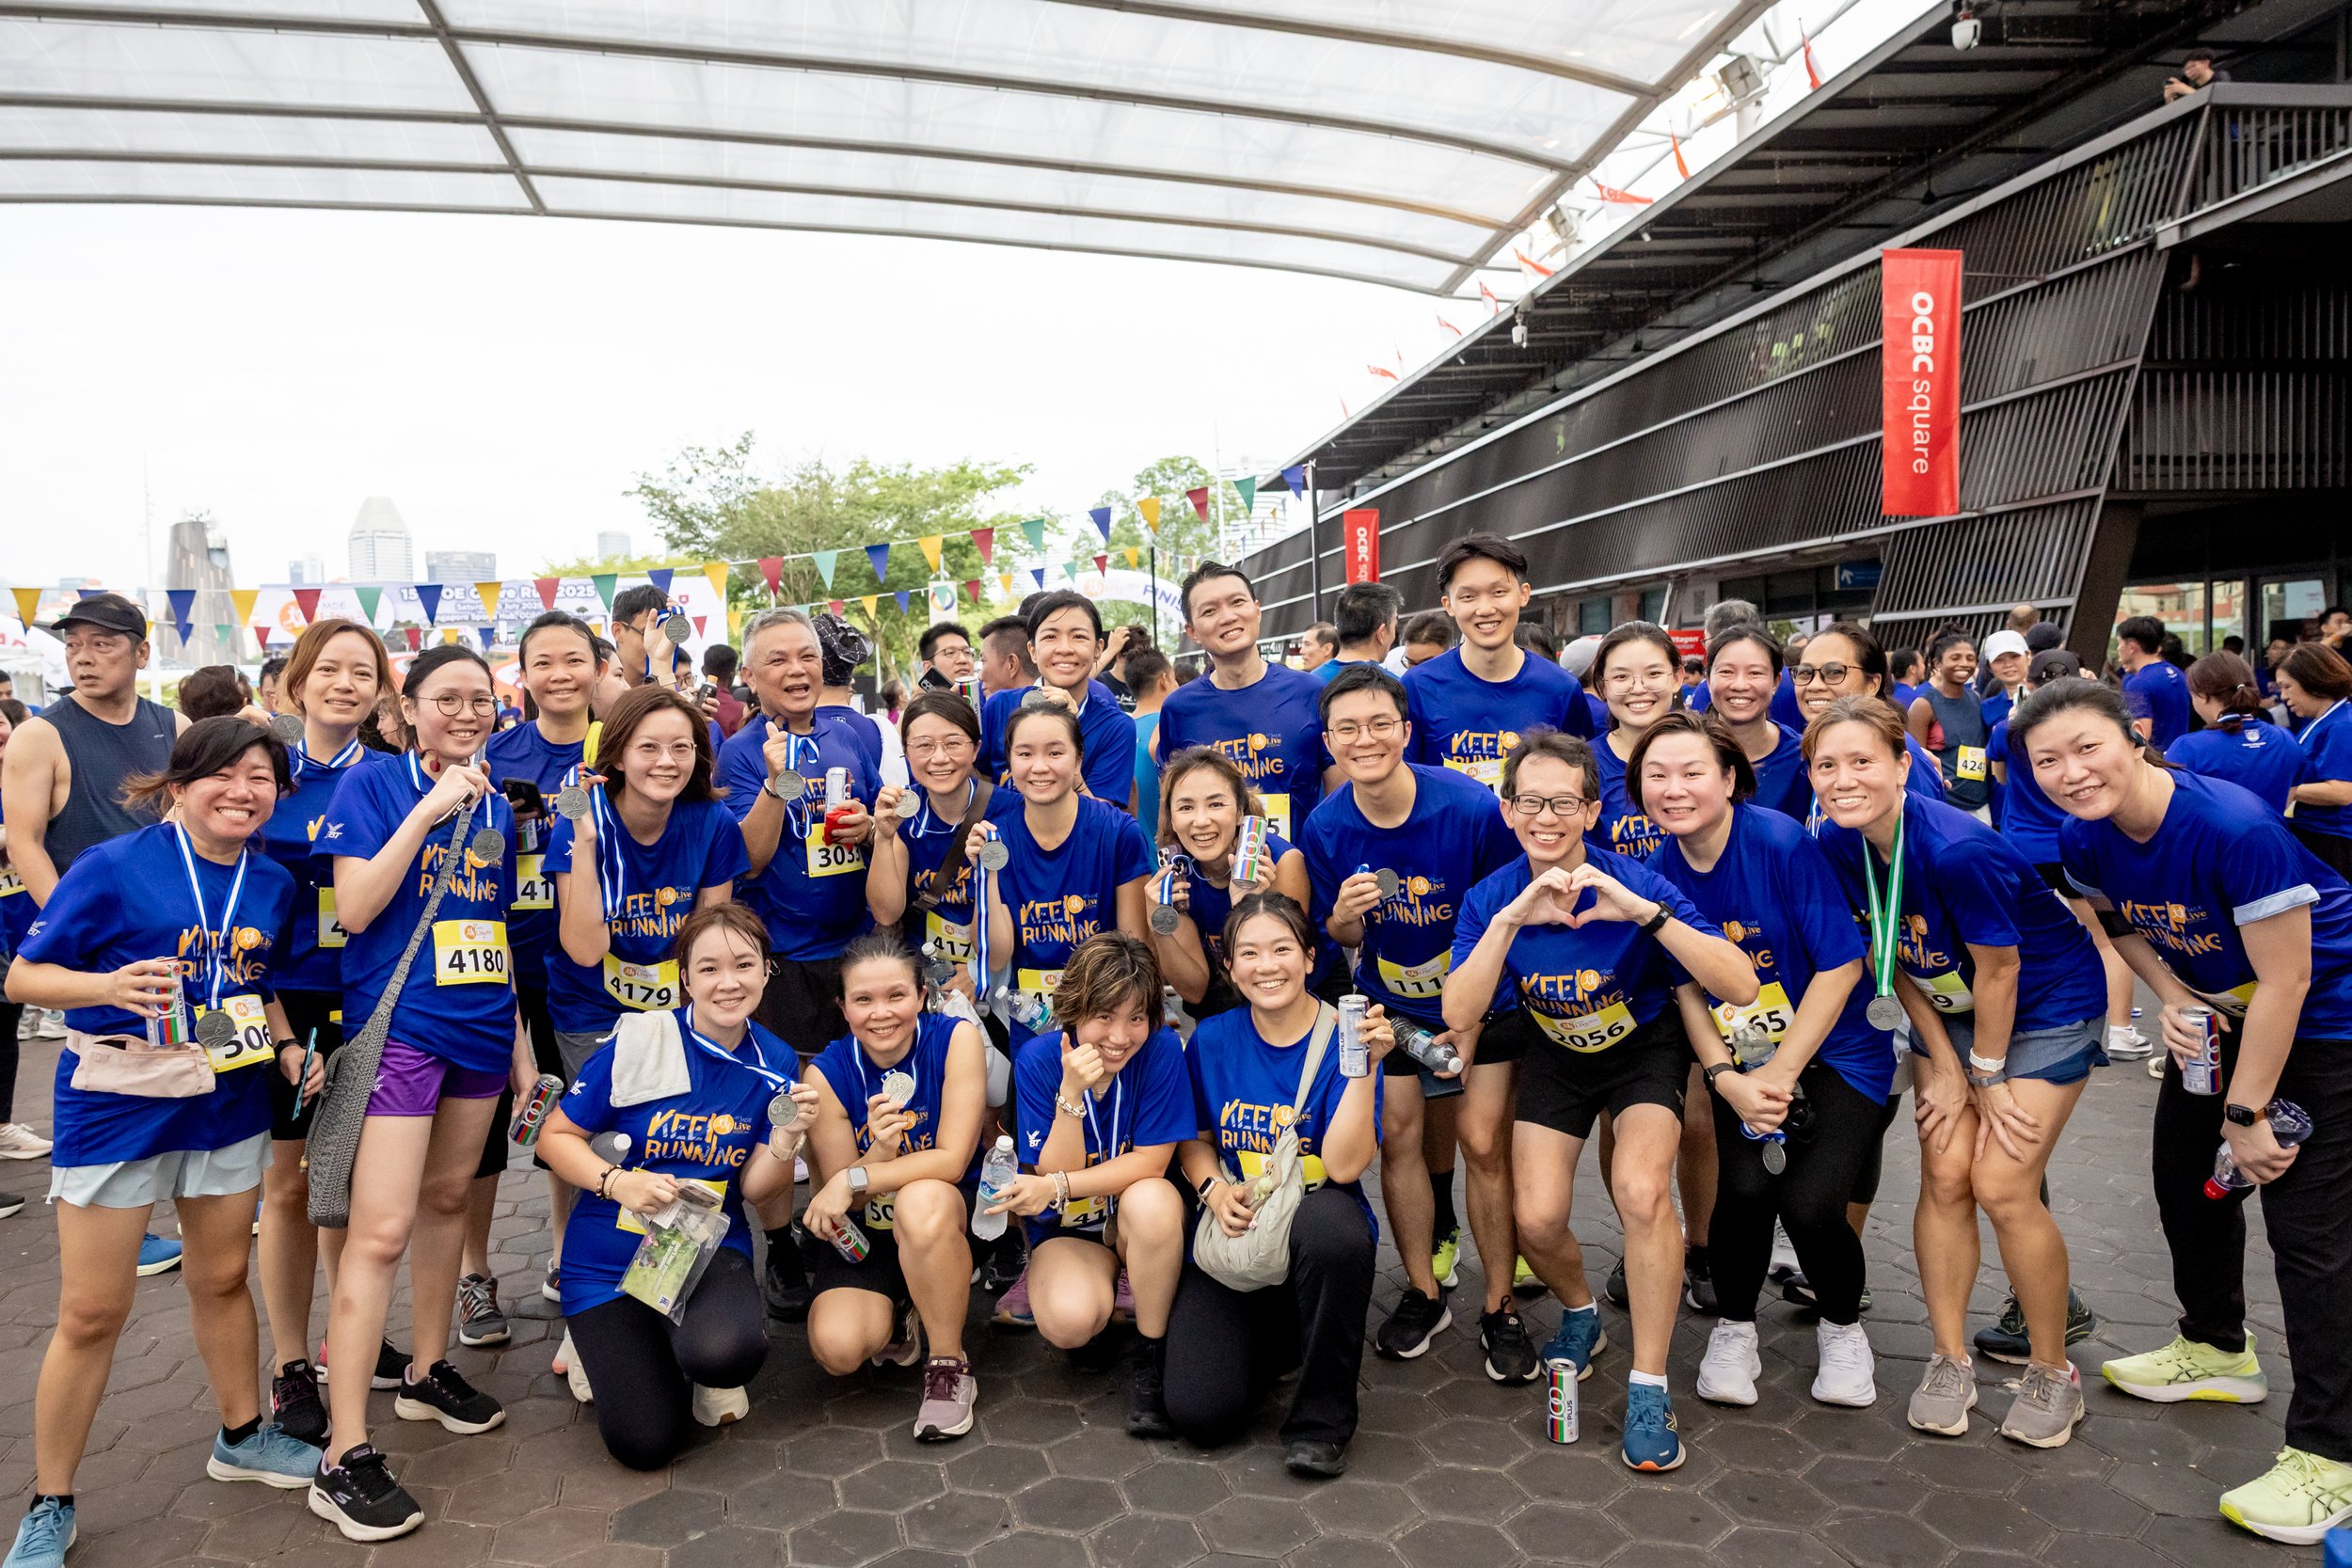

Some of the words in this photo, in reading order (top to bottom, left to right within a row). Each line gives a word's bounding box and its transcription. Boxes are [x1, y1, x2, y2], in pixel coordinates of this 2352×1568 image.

[1912, 292, 1934, 372] OCBC
[1906, 379, 1931, 474] square
[1357, 527, 1369, 562] OCBC
[440, 586, 467, 600] OE
[556, 584, 596, 598] 2025
[1022, 914, 1101, 946] RUNNING
[448, 948, 503, 974] 4180
[611, 976, 672, 1006] 4179
[1520, 969, 1600, 1002] KEEP
[1550, 1022, 1626, 1048] 2056
[646, 1108, 735, 1143] KEEP
[734, 1122, 752, 1131] Live
[1220, 1099, 1295, 1134] KEEP
[644, 1134, 747, 1167] RUNNING
